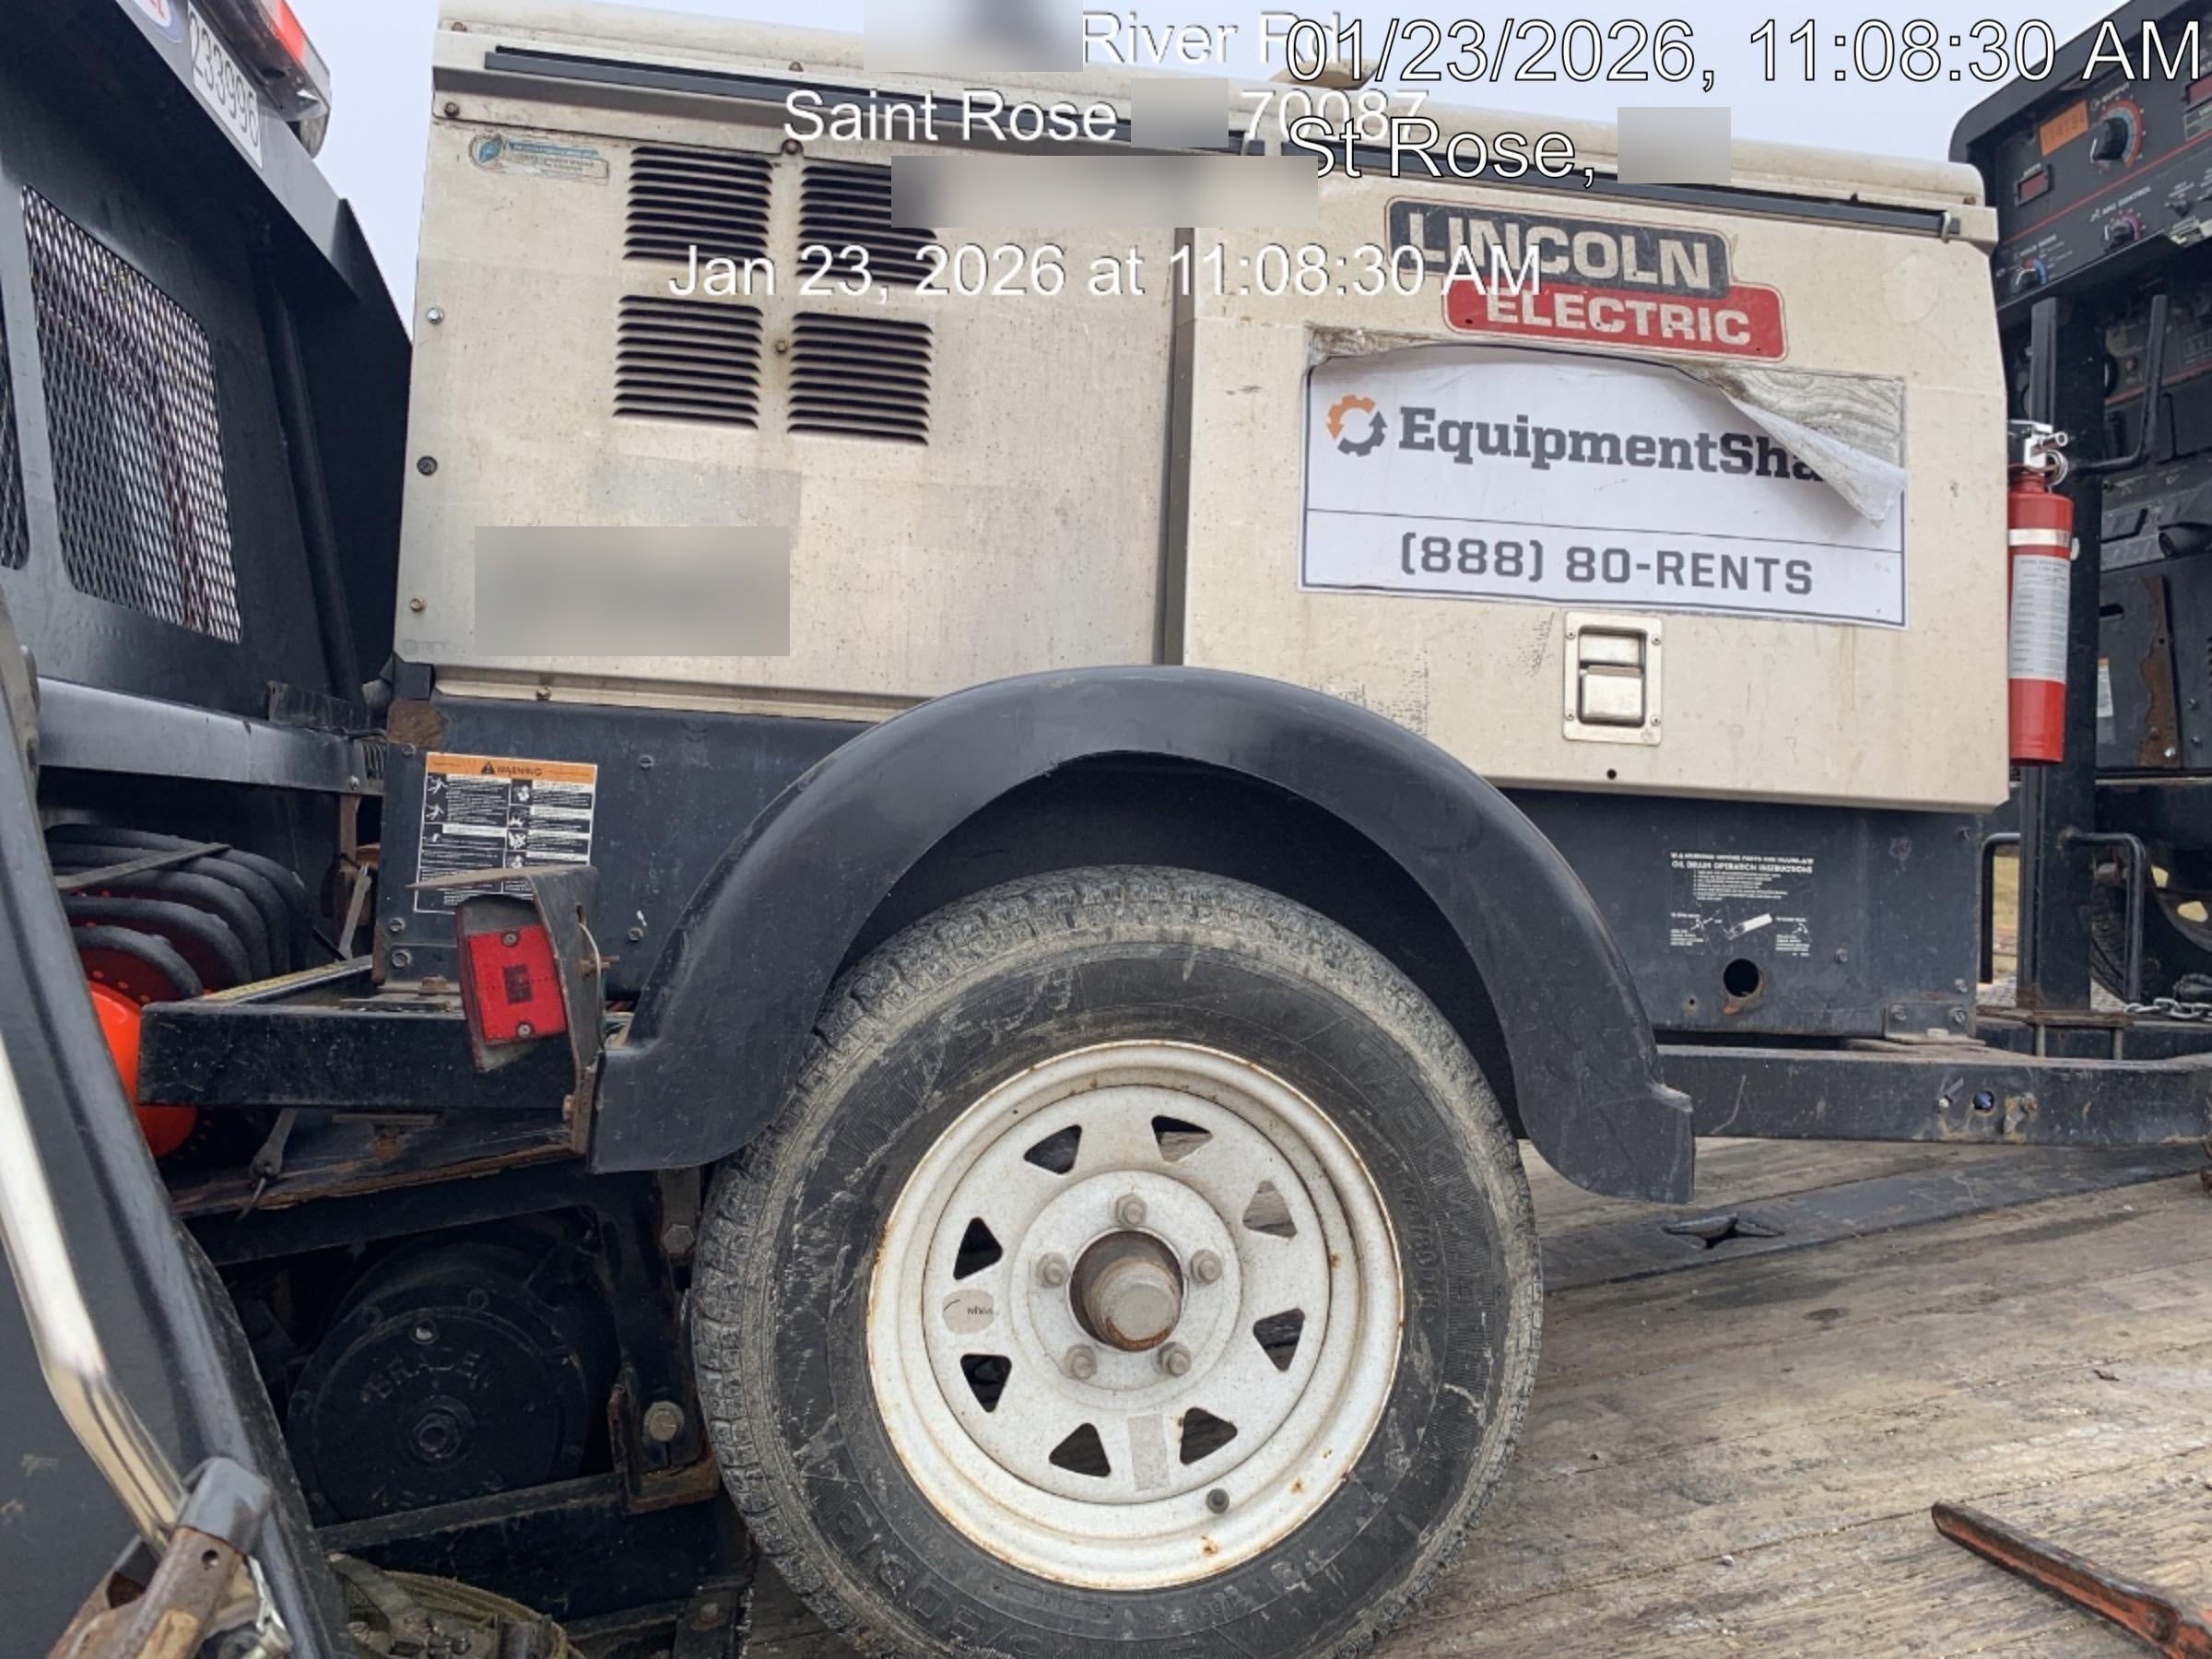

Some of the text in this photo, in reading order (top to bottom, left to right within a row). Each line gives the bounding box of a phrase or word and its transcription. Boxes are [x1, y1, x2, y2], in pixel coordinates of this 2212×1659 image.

[1409, 211, 1712, 290] LINCOLN
[1485, 285, 1752, 347] ELECTRIC
[1397, 406, 1823, 483] EquipmentSha
[1400, 532, 1814, 596] (888) 80-RENTS
[496, 765, 543, 777] WARNING
